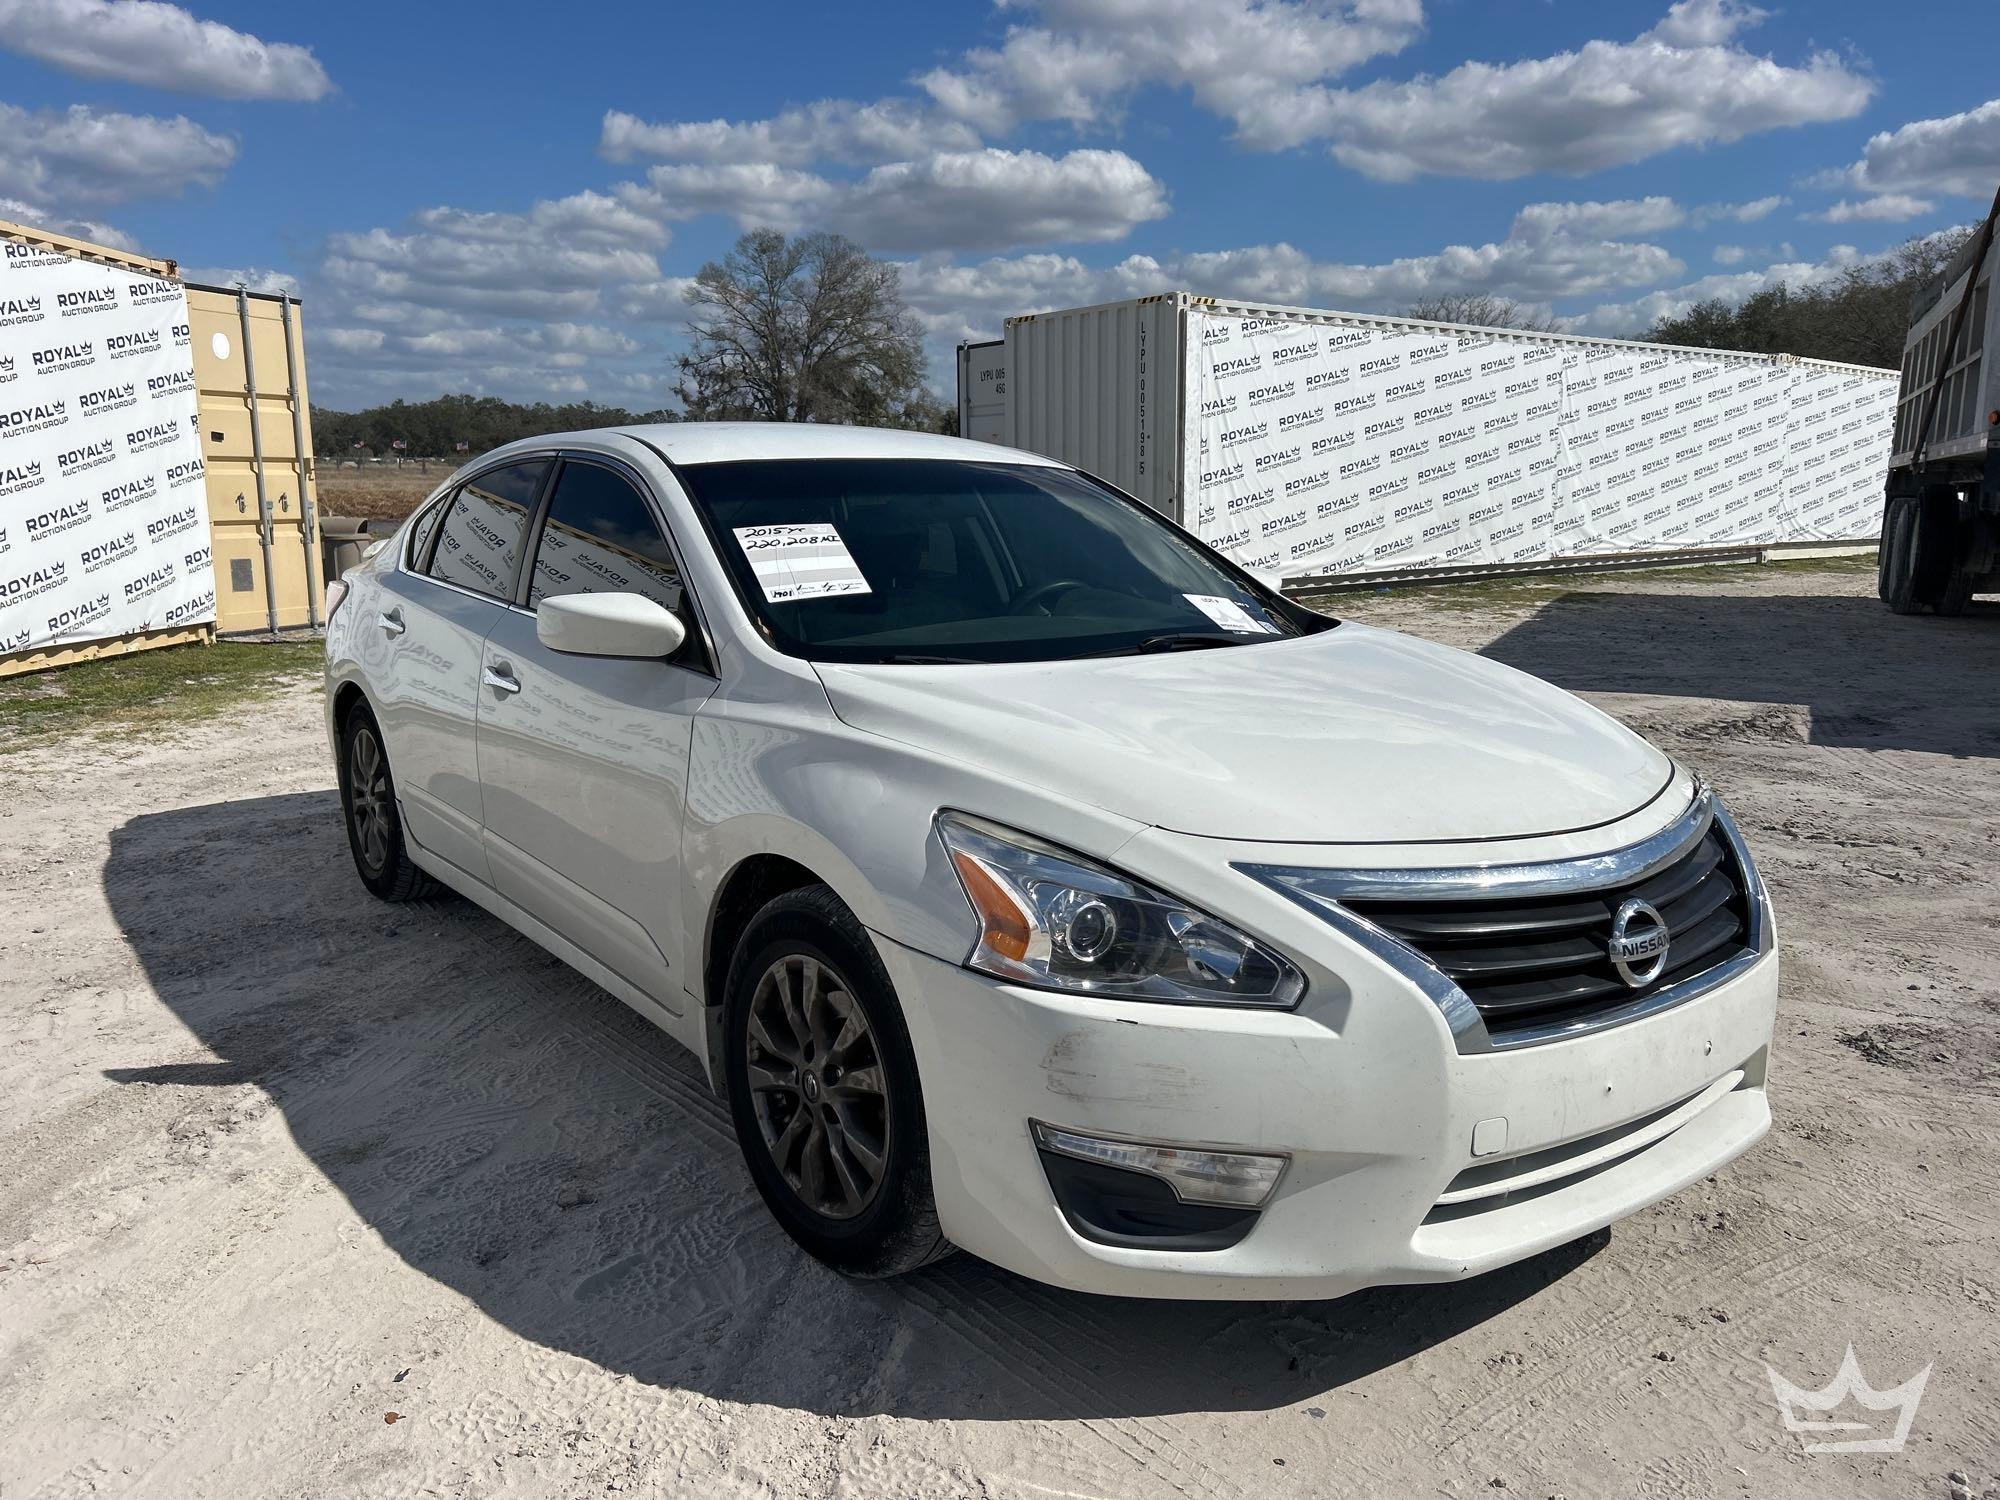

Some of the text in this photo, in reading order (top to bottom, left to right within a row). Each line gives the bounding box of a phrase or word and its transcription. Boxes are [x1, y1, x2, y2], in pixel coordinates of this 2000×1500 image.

[10, 255, 72, 269] AUCTION GROUP
[129, 281, 171, 297] ROYAL
[57, 289, 105, 307] ROYAL
[132, 293, 183, 306] AUCTION GROUP
[61, 302, 118, 317] AUCTION GROUP
[16, 313, 45, 324] GROUP
[106, 331, 150, 351] ROYAL
[1328, 331, 1362, 347] ROYAL
[32, 345, 81, 365] ROYAL
[110, 343, 162, 360] AUCTION GROUP
[1272, 344, 1308, 360] ROYAL
[37, 357, 96, 376] AUCTION GROUP
[1213, 358, 1250, 373] ROYAL
[1360, 357, 1392, 372] ROYAL
[1480, 358, 1508, 372] ROYAL
[147, 371, 188, 390] ROYAL
[1306, 370, 1341, 386] ROYAL
[1434, 370, 1464, 384] ROYAL
[151, 389, 178, 400] AUCTION
[1248, 384, 1285, 400] ROYAL
[1385, 382, 1417, 397] ROYAL
[1504, 381, 1531, 394] ROYAL
[79, 387, 124, 408] ROYAL
[1334, 395, 1367, 411] ROYAL
[1461, 392, 1490, 407] ROYAL
[83, 397, 138, 418] AUCTION GROUP
[1526, 403, 1552, 416] ROYAL
[0, 405, 55, 428] ROYAL
[1279, 410, 1315, 426] ROYAL
[1484, 415, 1511, 430] ROYAL
[2, 416, 69, 439] AUCTION GROUP
[126, 424, 168, 445] ROYAL
[1220, 426, 1258, 442] ROYAL
[1364, 419, 1396, 435] ROYAL
[130, 433, 180, 454] AUCTION GROUP
[1312, 434, 1346, 450] ROYAL
[1438, 428, 1468, 444] ROYAL
[1508, 437, 1534, 450] ROYAL
[57, 444, 103, 468] ROYAL
[1255, 450, 1291, 467] ROYAL
[1389, 443, 1421, 458] ROYAL
[62, 453, 116, 478] AUCTION GROUP
[1340, 458, 1372, 474] ROYAL
[14, 477, 45, 492] GROUP
[170, 474, 196, 489] AUCTION
[1285, 474, 1320, 491] ROYAL
[1369, 480, 1400, 496] ROYAL
[102, 480, 145, 505] ROYAL
[105, 488, 157, 513] AUCTION GROUP
[1227, 492, 1265, 509] ROYAL
[1443, 486, 1472, 501] ROYAL
[1511, 491, 1538, 505] ROYAL
[1317, 497, 1351, 514] ROYAL
[1394, 502, 1425, 518] ROYAL
[1469, 505, 1497, 521] ROYAL
[25, 505, 78, 533] ROYAL
[147, 512, 186, 536] ROYAL
[1261, 514, 1297, 532] ROYAL
[30, 514, 92, 543] AUCTION GROUP
[151, 519, 199, 544] AUCTION GROUP
[1344, 519, 1376, 536] ROYAL
[81, 538, 125, 565] ROYAL
[1291, 537, 1325, 554] ROYAL
[1374, 539, 1406, 556] ROYAL
[1446, 542, 1474, 558] ROYAL
[84, 545, 138, 574] AUCTION GROUP
[124, 569, 165, 596] ROYAL
[127, 576, 176, 605] AUCTION GROUP
[0, 576, 69, 609] AUCTION GROUP
[48, 601, 98, 631] ROYAL
[165, 596, 205, 622] ROYAL
[195, 602, 215, 616] GROUP
[50, 607, 112, 639] AUCTION GROUP
